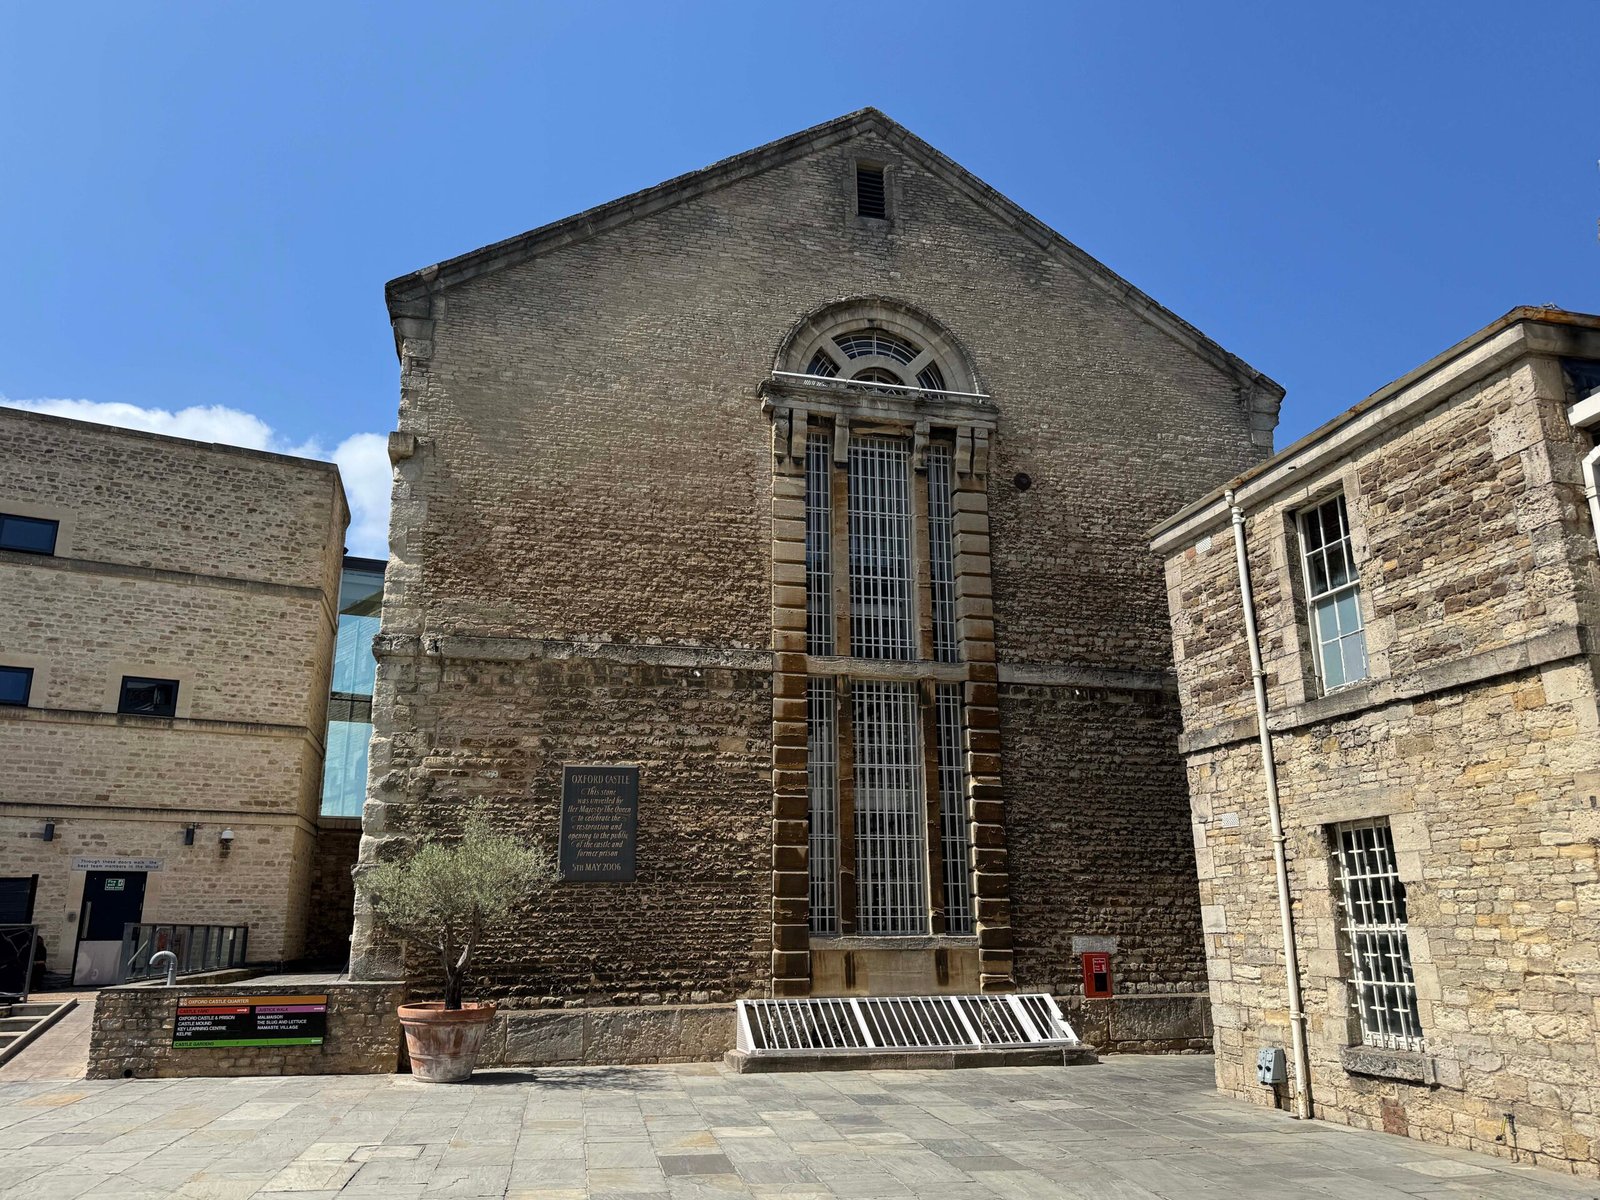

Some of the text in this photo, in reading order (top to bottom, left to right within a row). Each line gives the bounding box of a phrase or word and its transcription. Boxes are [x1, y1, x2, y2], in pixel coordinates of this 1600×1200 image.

[572, 775, 630, 784] OXFORD CASTLE
[581, 786, 599, 795] This
[616, 796, 624, 805] by
[585, 813, 611, 821] celebrate
[610, 831, 628, 840] public
[576, 849, 598, 859] former
